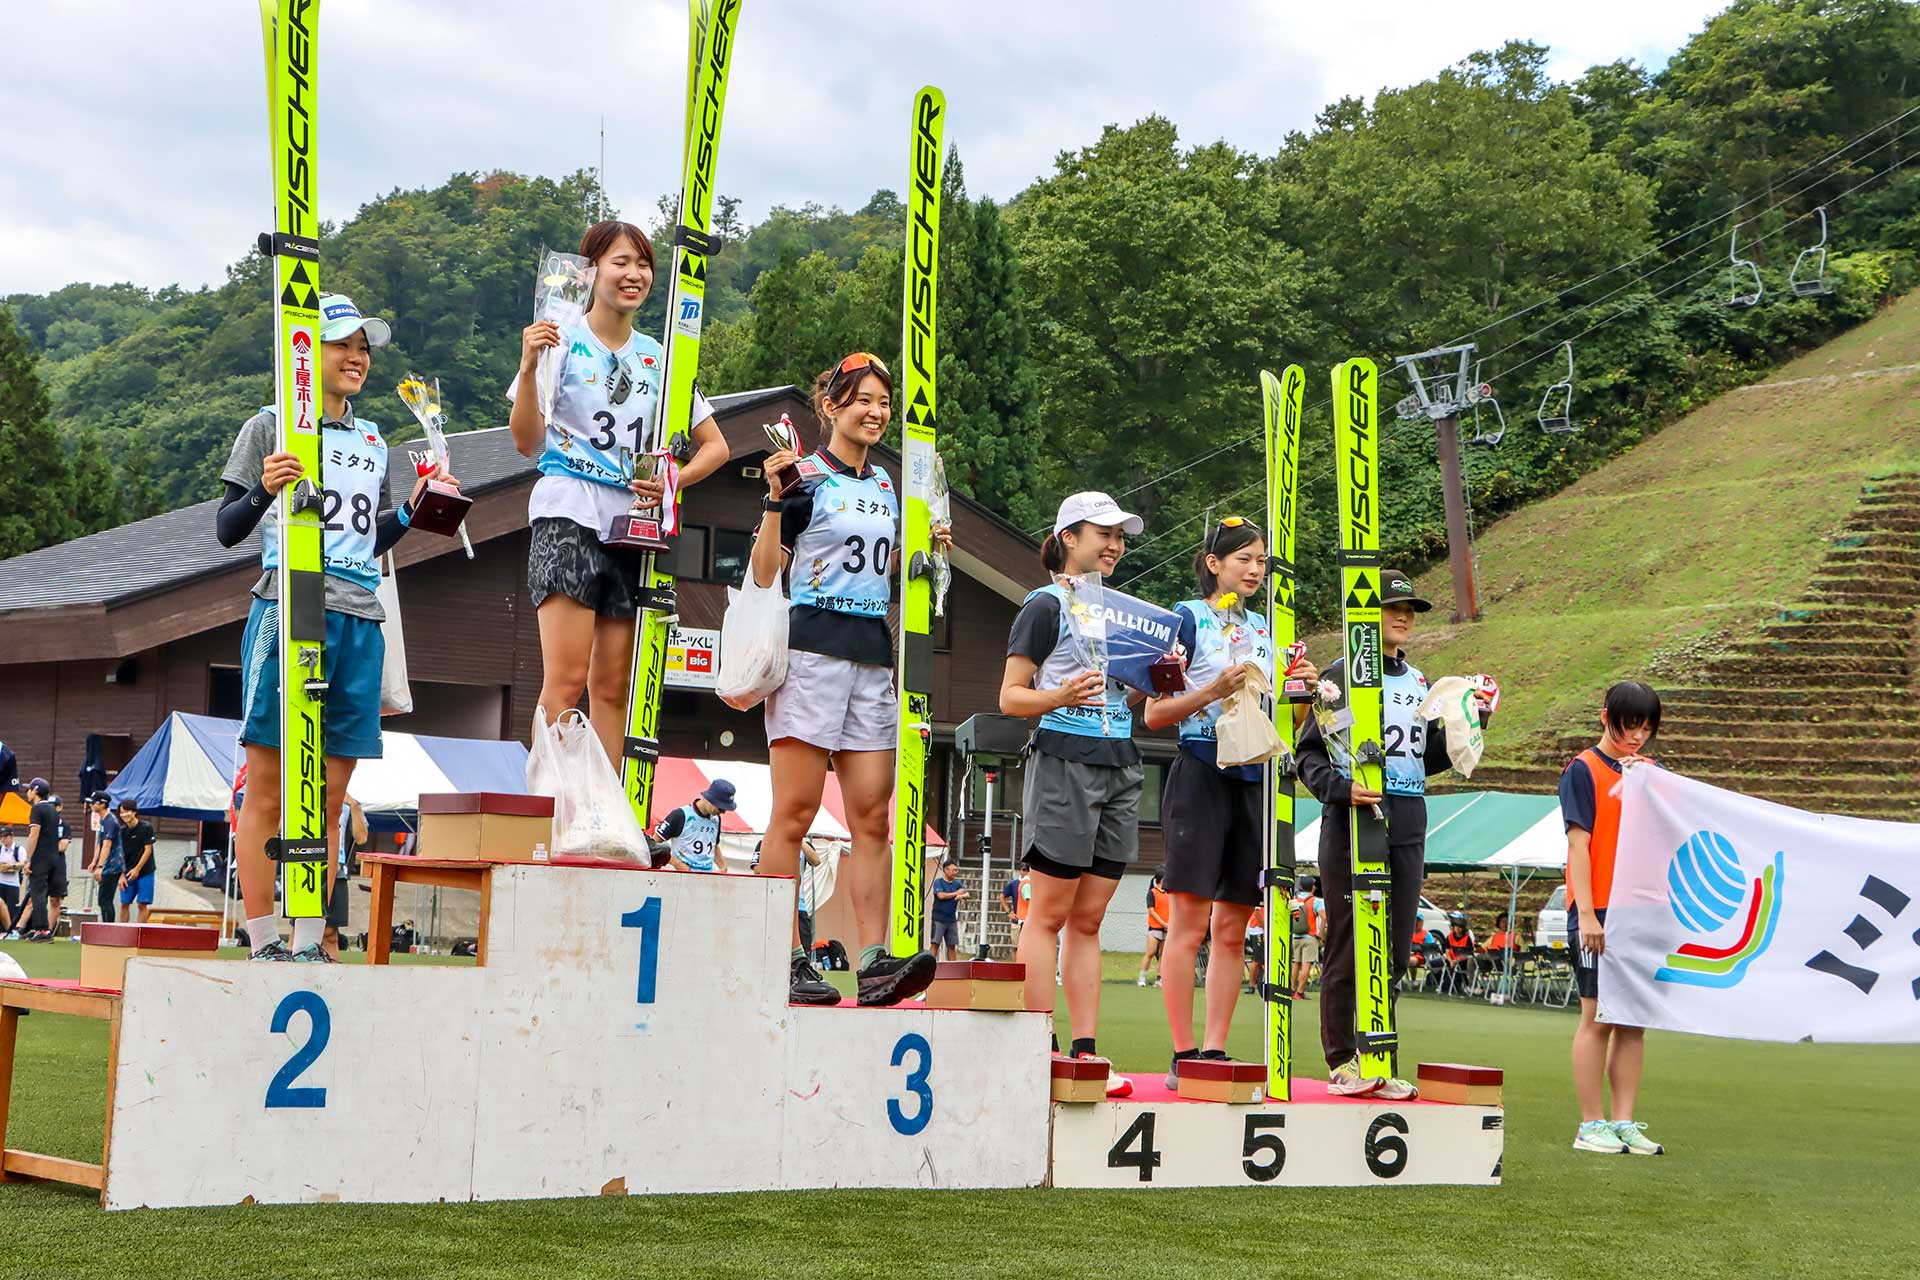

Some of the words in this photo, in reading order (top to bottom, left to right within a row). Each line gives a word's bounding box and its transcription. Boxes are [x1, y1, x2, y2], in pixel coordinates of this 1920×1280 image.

[288, 0, 310, 236] FISCHER
[691, 0, 736, 230] FISCHER
[911, 93, 940, 383] FISCHER
[284, 310, 319, 319] FISCHER
[296, 356, 312, 430] 土屋ホーム
[330, 449, 375, 473] ミタカ
[590, 410, 643, 453] 31
[908, 427, 934, 436] FISCHER
[1280, 370, 1300, 560] FISCHER
[1350, 364, 1370, 549] FISCHER
[323, 490, 371, 535] 28
[856, 499, 890, 516] ミタカ
[843, 535, 890, 576] 30
[1088, 603, 1171, 643] GALLIUM
[1363, 623, 1372, 686] INFINITY
[1385, 725, 1422, 758] 25
[301, 711, 315, 893] FISCHR
[693, 840, 713, 855] 91
[903, 781, 918, 939] FISCHER
[621, 897, 661, 1004] 1
[1276, 936, 1287, 1080] FISHER
[264, 990, 330, 1108] 2
[887, 1033, 934, 1136] 3
[1107, 1112, 1161, 1181] 4
[1242, 1114, 1286, 1182] 5
[1365, 1112, 1409, 1180] 6
